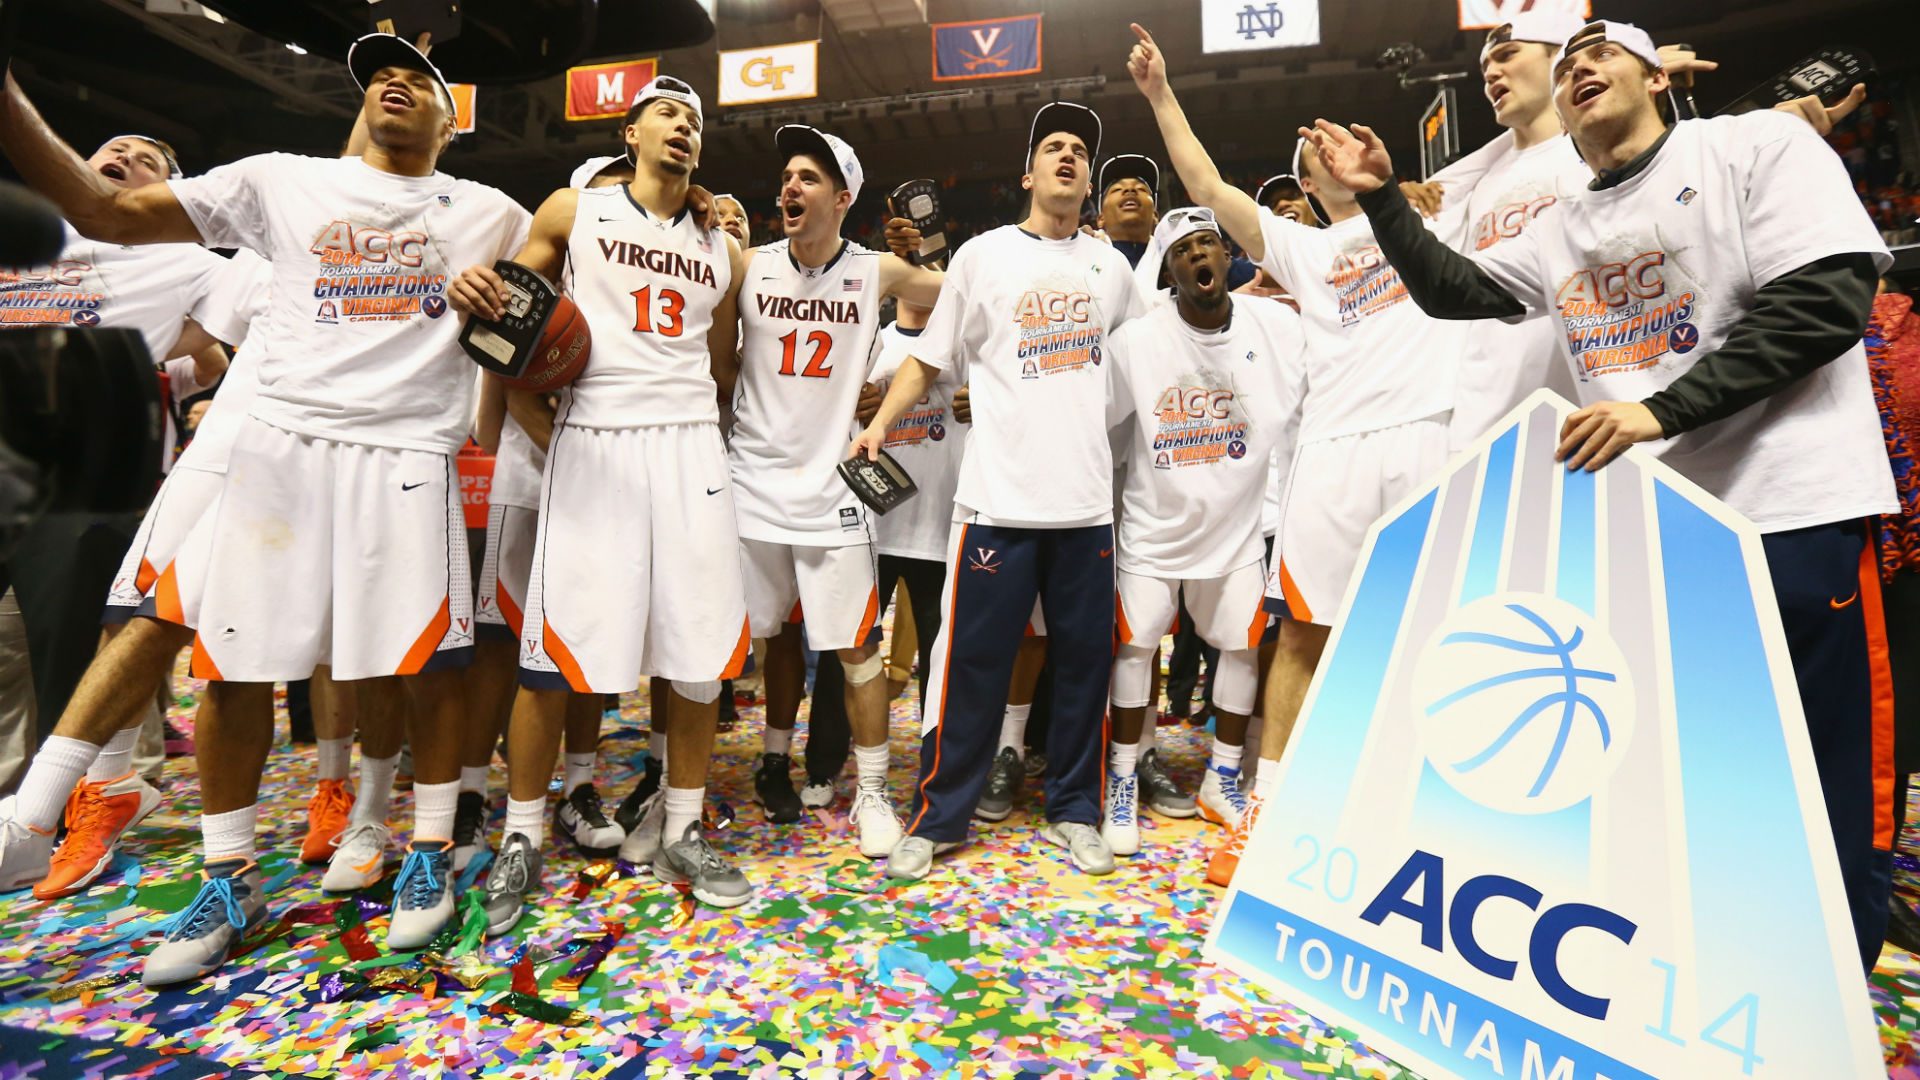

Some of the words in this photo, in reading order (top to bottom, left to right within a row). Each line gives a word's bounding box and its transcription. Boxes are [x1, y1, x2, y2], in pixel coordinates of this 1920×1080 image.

[597, 71, 625, 105] M
[740, 56, 794, 91] GT
[1798, 67, 1830, 85] ACC
[310, 220, 428, 267] ACC
[320, 249, 363, 267] 2014
[320, 265, 400, 276] TOURNAMENT
[597, 237, 717, 290] VIRGINIA
[1325, 246, 1387, 284] AC
[314, 275, 446, 298] CHAMPIONS
[1339, 268, 1398, 313] CHAMPI
[1556, 251, 1665, 309] ACC
[0, 291, 104, 309] AMPIONS
[342, 297, 420, 315] VIRGINIA
[629, 284, 685, 337] 13
[756, 293, 860, 324] VIRGINIA
[1013, 291, 1091, 323] ACC
[1562, 301, 1607, 317] 2014
[1020, 316, 1050, 328] 2014
[1020, 323, 1075, 339] TOURNAMENT
[1565, 302, 1644, 330] OURNAMENT
[778, 328, 833, 378] 12
[1018, 328, 1102, 358] CHAMPIONS
[1040, 347, 1090, 369] VIRGINIA
[1584, 333, 1668, 371] VIRGINIA
[1153, 387, 1234, 419] ACC
[1160, 411, 1188, 422] 2014
[1154, 423, 1246, 449] CHAMPIONS
[1173, 443, 1227, 462] VIRGINIA
[1286, 834, 1358, 903] 20
[1359, 849, 1638, 1021] ACC
[1275, 921, 1616, 1080] TOURNAM
[1645, 957, 1765, 1076] 14
